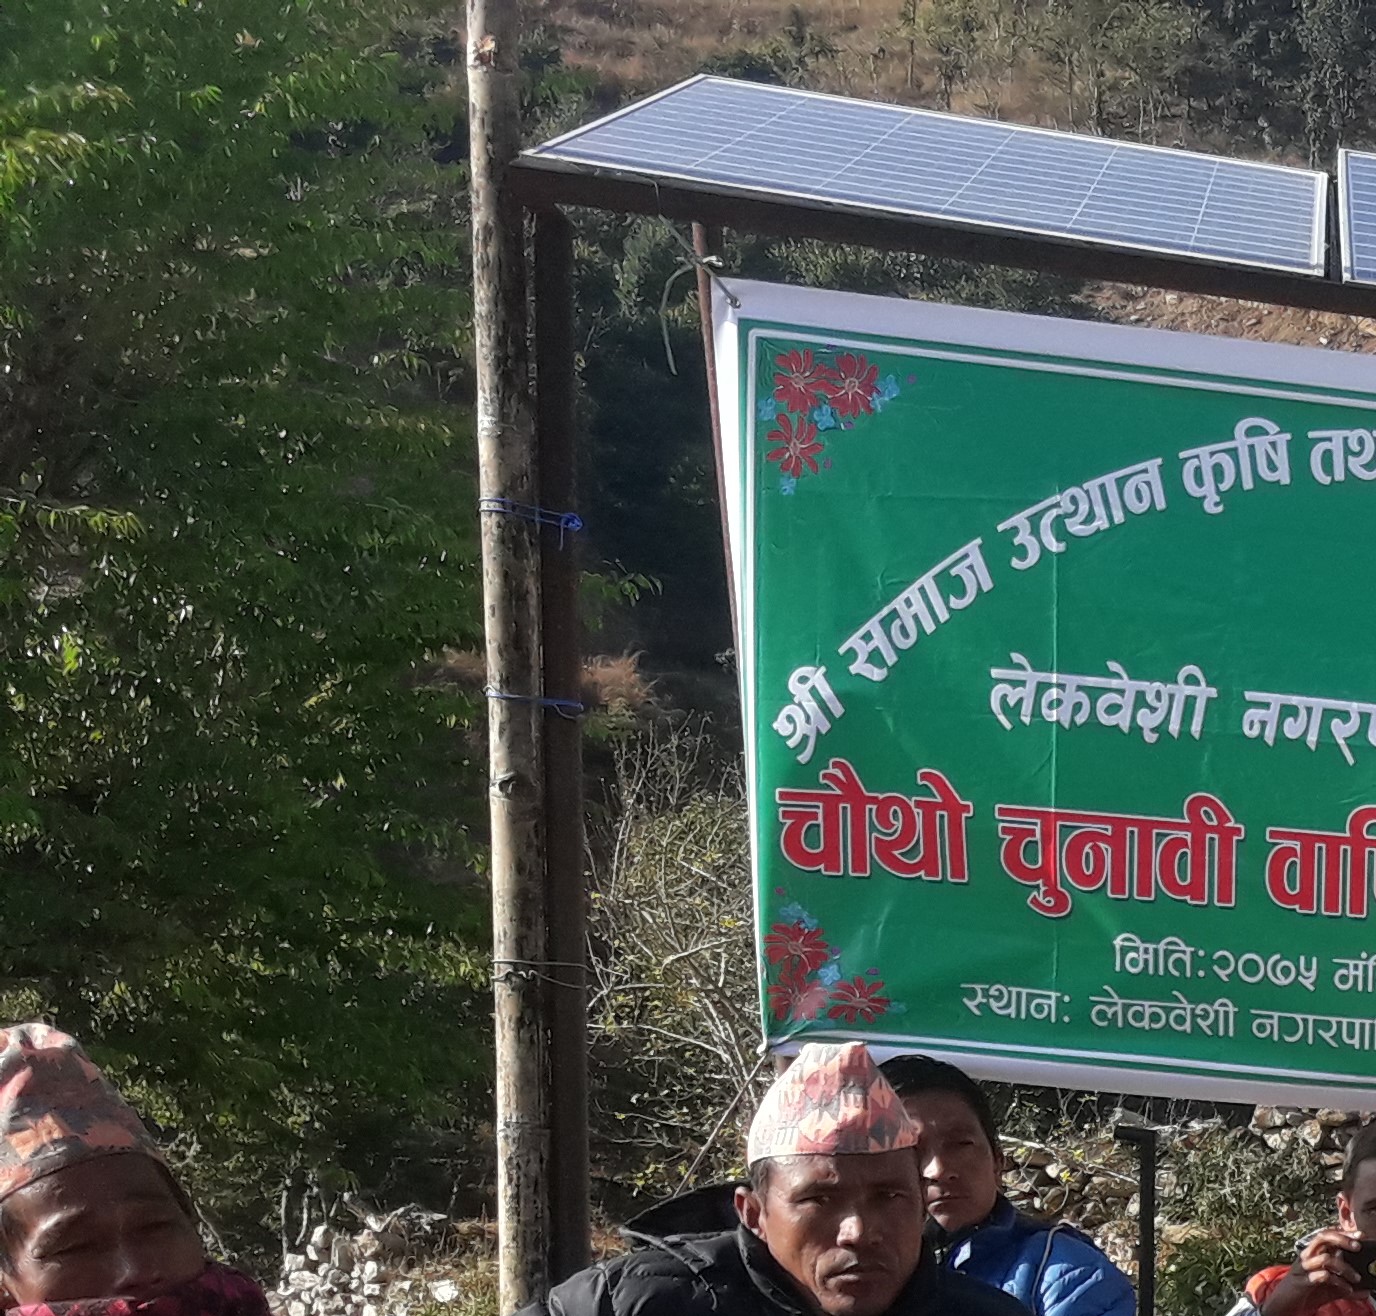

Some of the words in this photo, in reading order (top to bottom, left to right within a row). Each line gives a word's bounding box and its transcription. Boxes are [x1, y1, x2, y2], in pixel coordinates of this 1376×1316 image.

[772, 665, 845, 765] श्री
[837, 537, 994, 682] समाज
[996, 457, 1166, 570] उत्थान
[1178, 417, 1292, 514] कृषि
[990, 652, 1218, 744] लेकवेशी
[775, 757, 974, 883] चौथो
[994, 792, 1245, 918] चुनावी
[1089, 985, 1238, 1037] लेकवेशी
